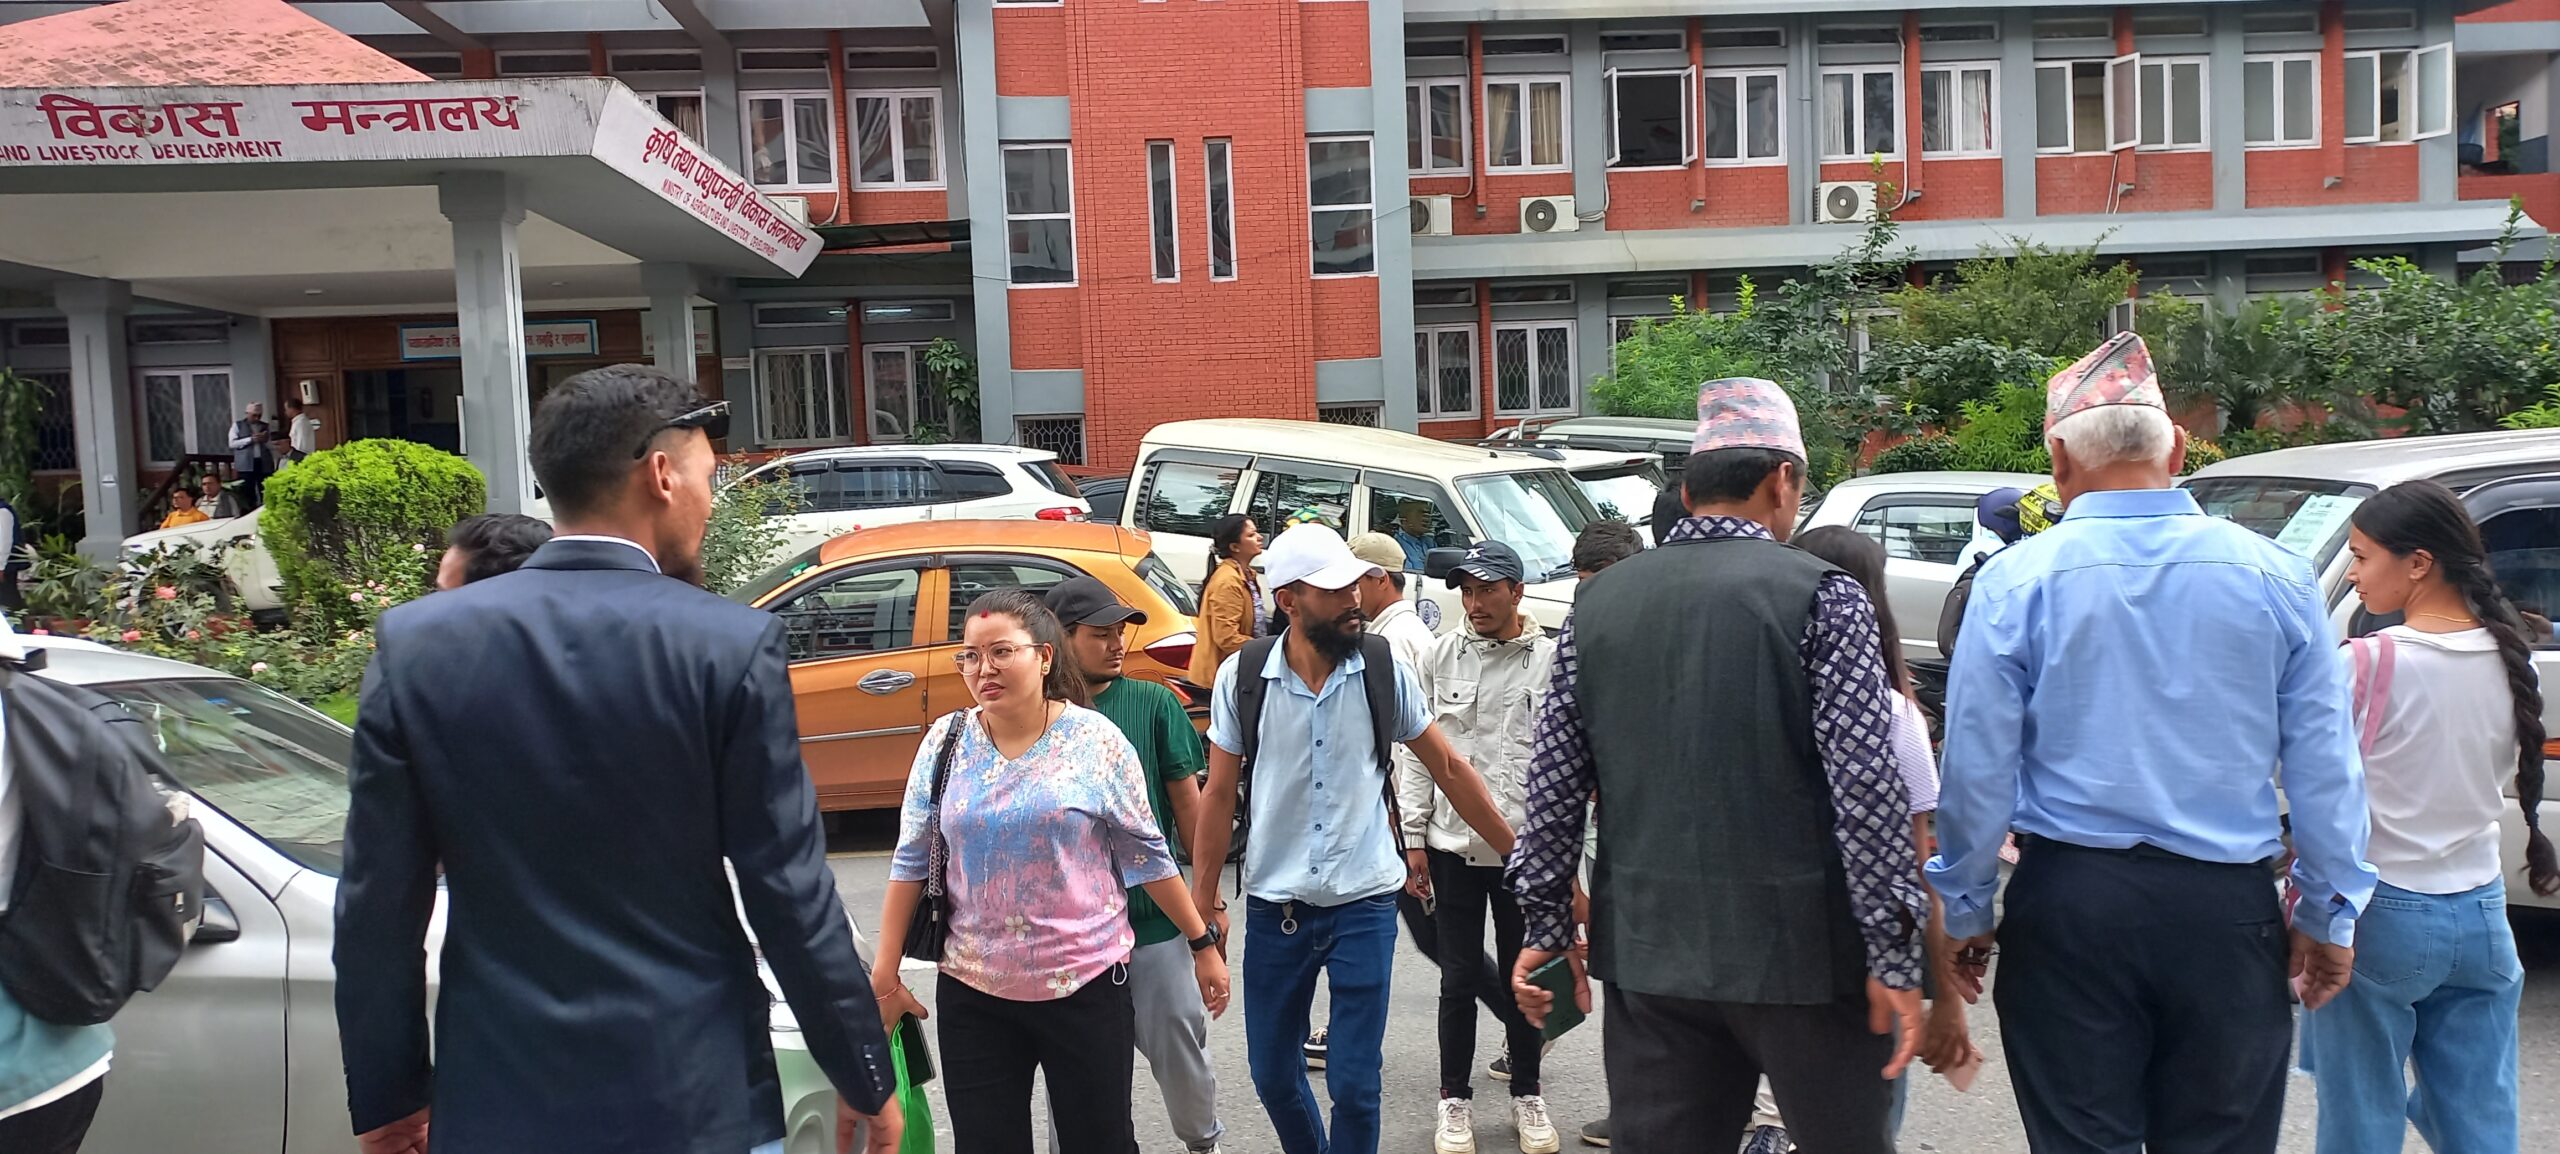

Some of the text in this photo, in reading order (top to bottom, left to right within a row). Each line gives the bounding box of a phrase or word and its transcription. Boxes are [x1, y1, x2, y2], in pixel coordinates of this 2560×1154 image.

[36, 93, 520, 140] विकास मन्त्रालय
[37, 144, 143, 161] LIVESTOCK
[152, 140, 283, 160] DEVELOPMENT
[643, 127, 678, 165] कृषि
[671, 146, 698, 179] तथा
[738, 191, 772, 230] विकास
[767, 216, 807, 253] मन्त्रालय
[662, 178, 685, 200] MINISTRY
[683, 192, 692, 205] OF
[691, 197, 722, 225] AGRICULTURE
[720, 215, 730, 229] AND
[727, 221, 751, 242] LIVESTOCK
